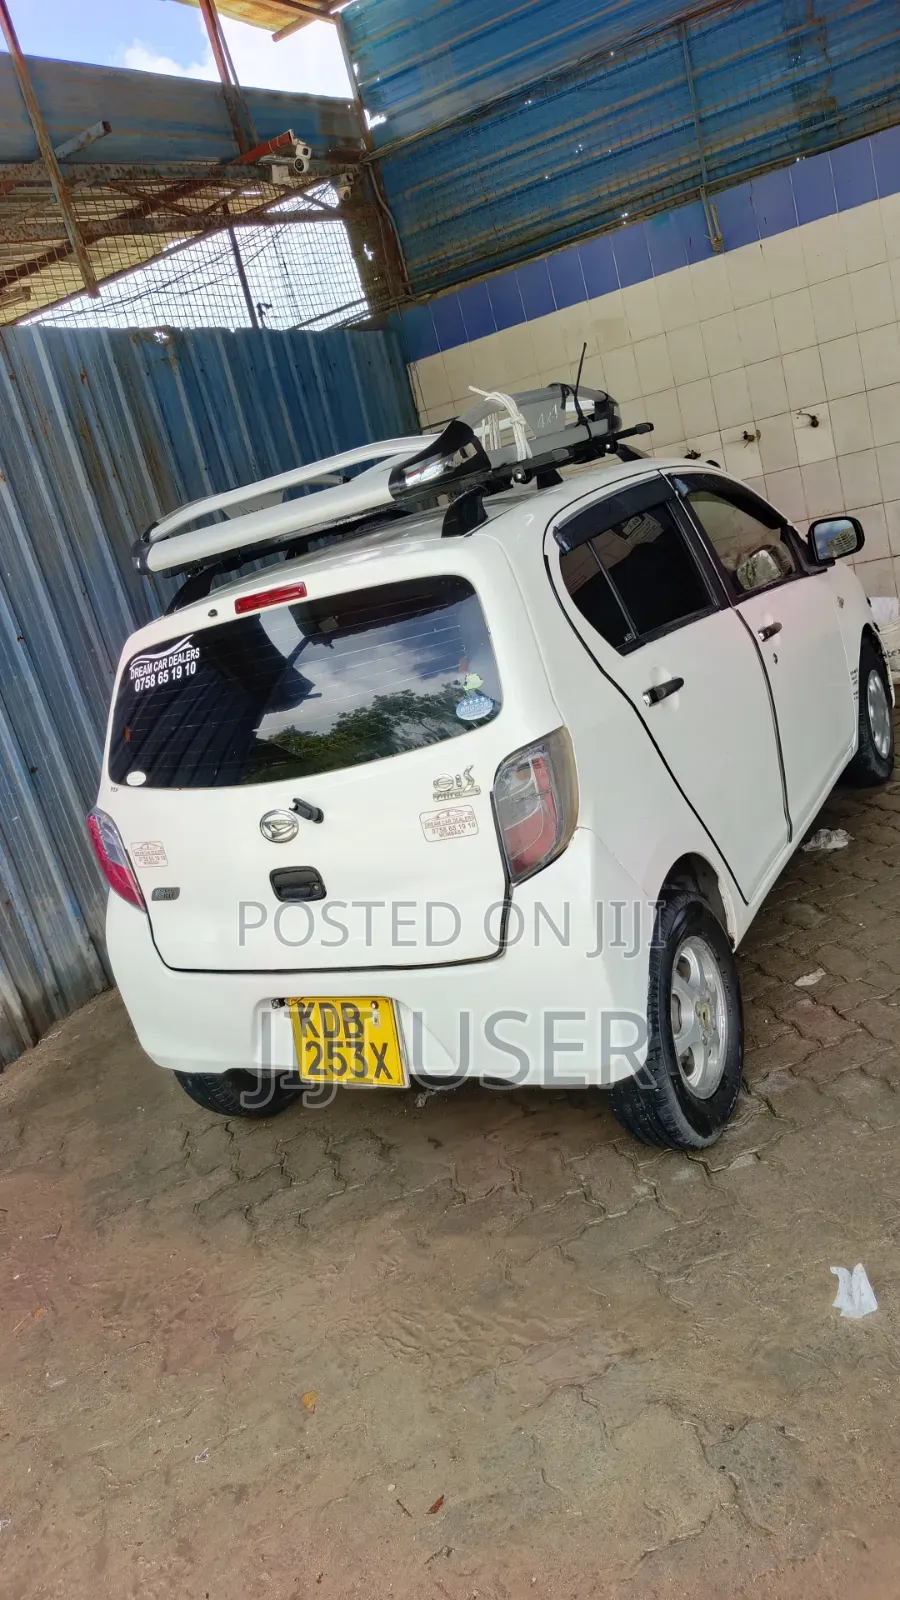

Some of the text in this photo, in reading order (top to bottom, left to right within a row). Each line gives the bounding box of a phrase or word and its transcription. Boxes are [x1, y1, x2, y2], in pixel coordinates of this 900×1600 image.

[130, 647, 200, 680] DREAM CAR DEALERS
[134, 661, 197, 692] 0758 65 19 10
[297, 1002, 364, 1039] KDB
[305, 1040, 394, 1080] 253X
